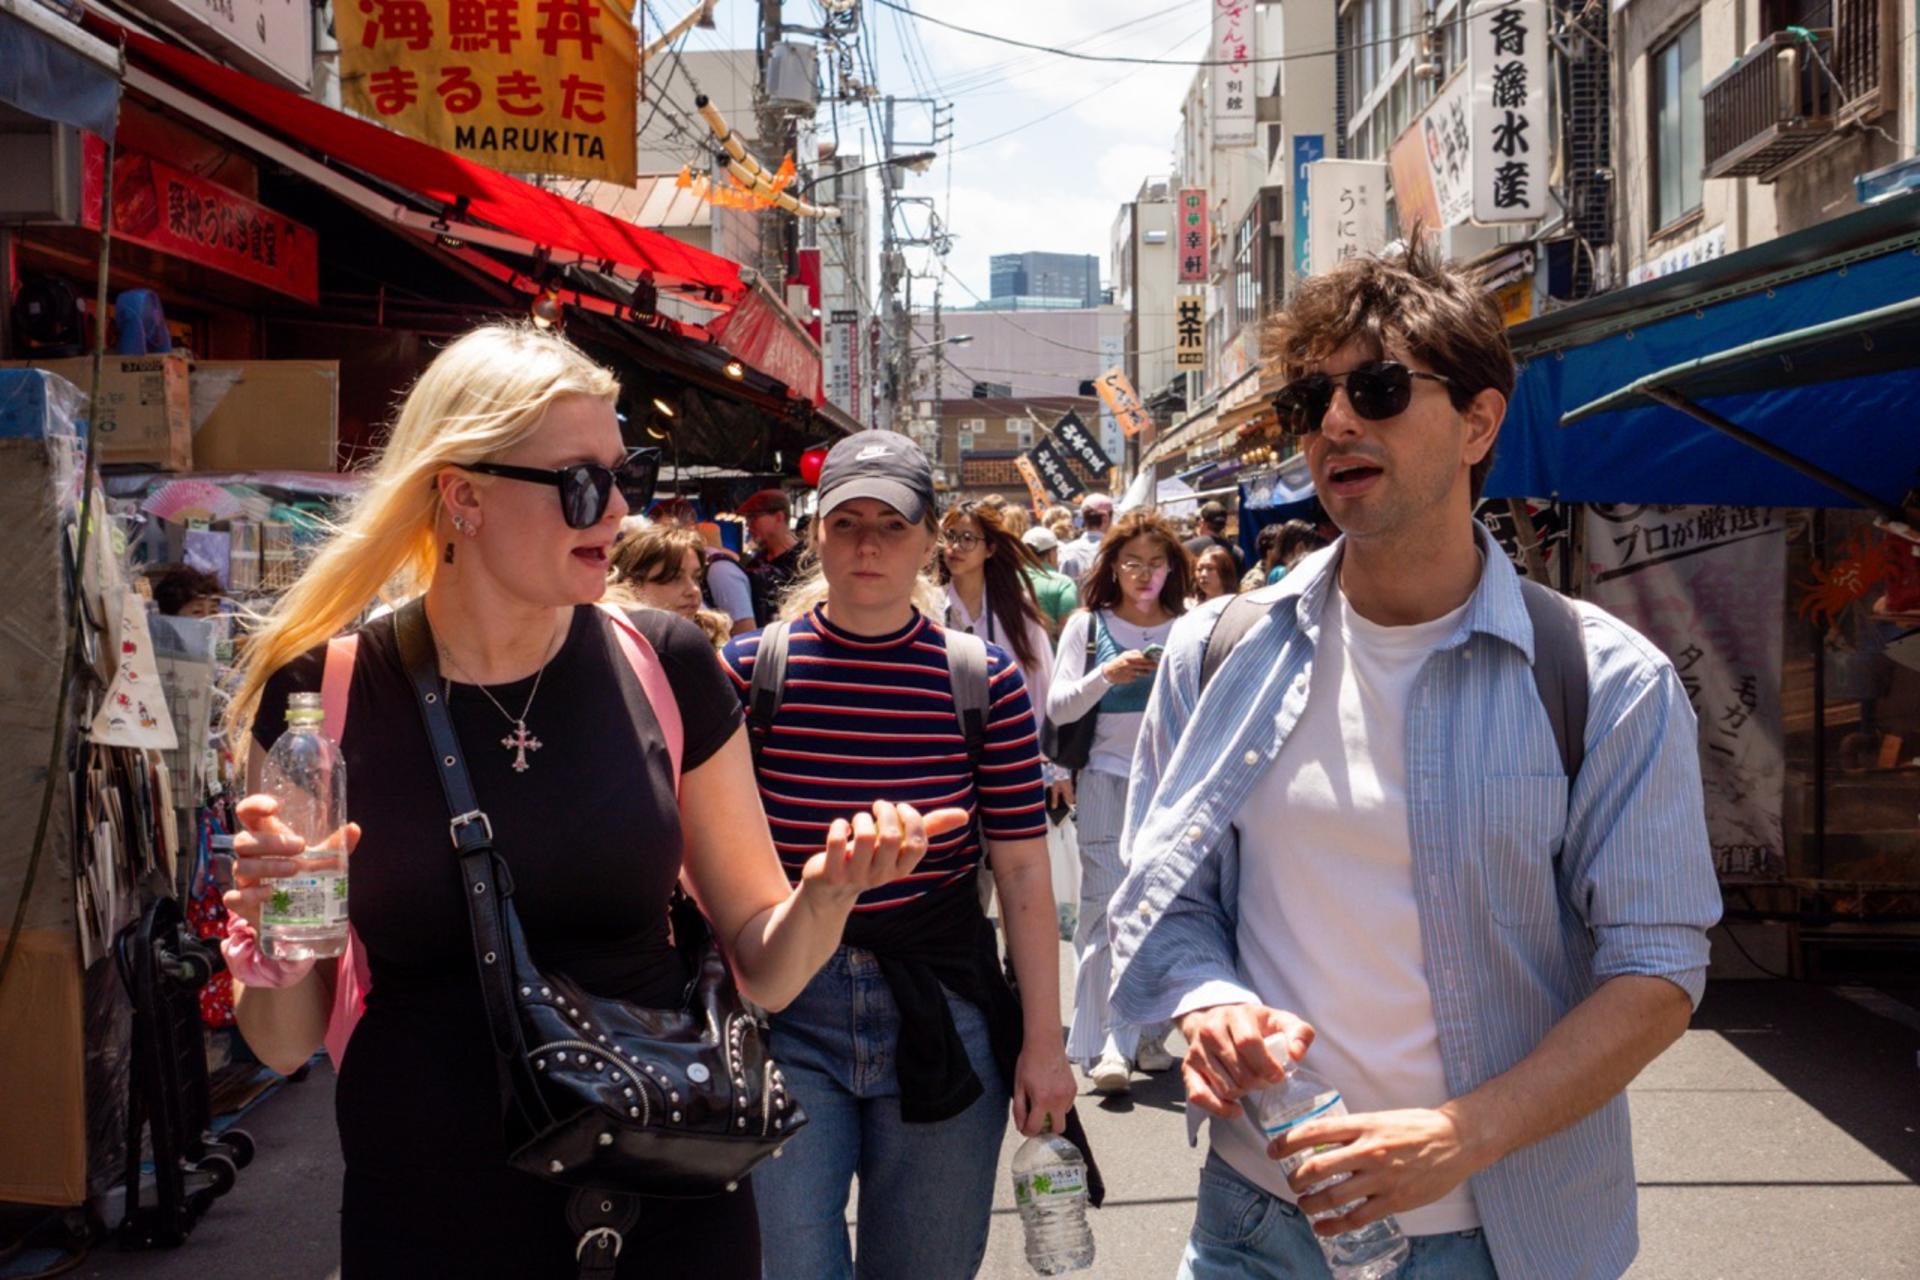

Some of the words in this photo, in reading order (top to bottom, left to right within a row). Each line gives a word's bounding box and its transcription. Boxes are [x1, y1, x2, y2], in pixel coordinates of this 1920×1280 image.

[358, 0, 604, 60] 海鮮丼
[368, 66, 606, 124] まるきた
[455, 125, 606, 160] MARUKITA
[1177, 301, 1203, 348] 茶
